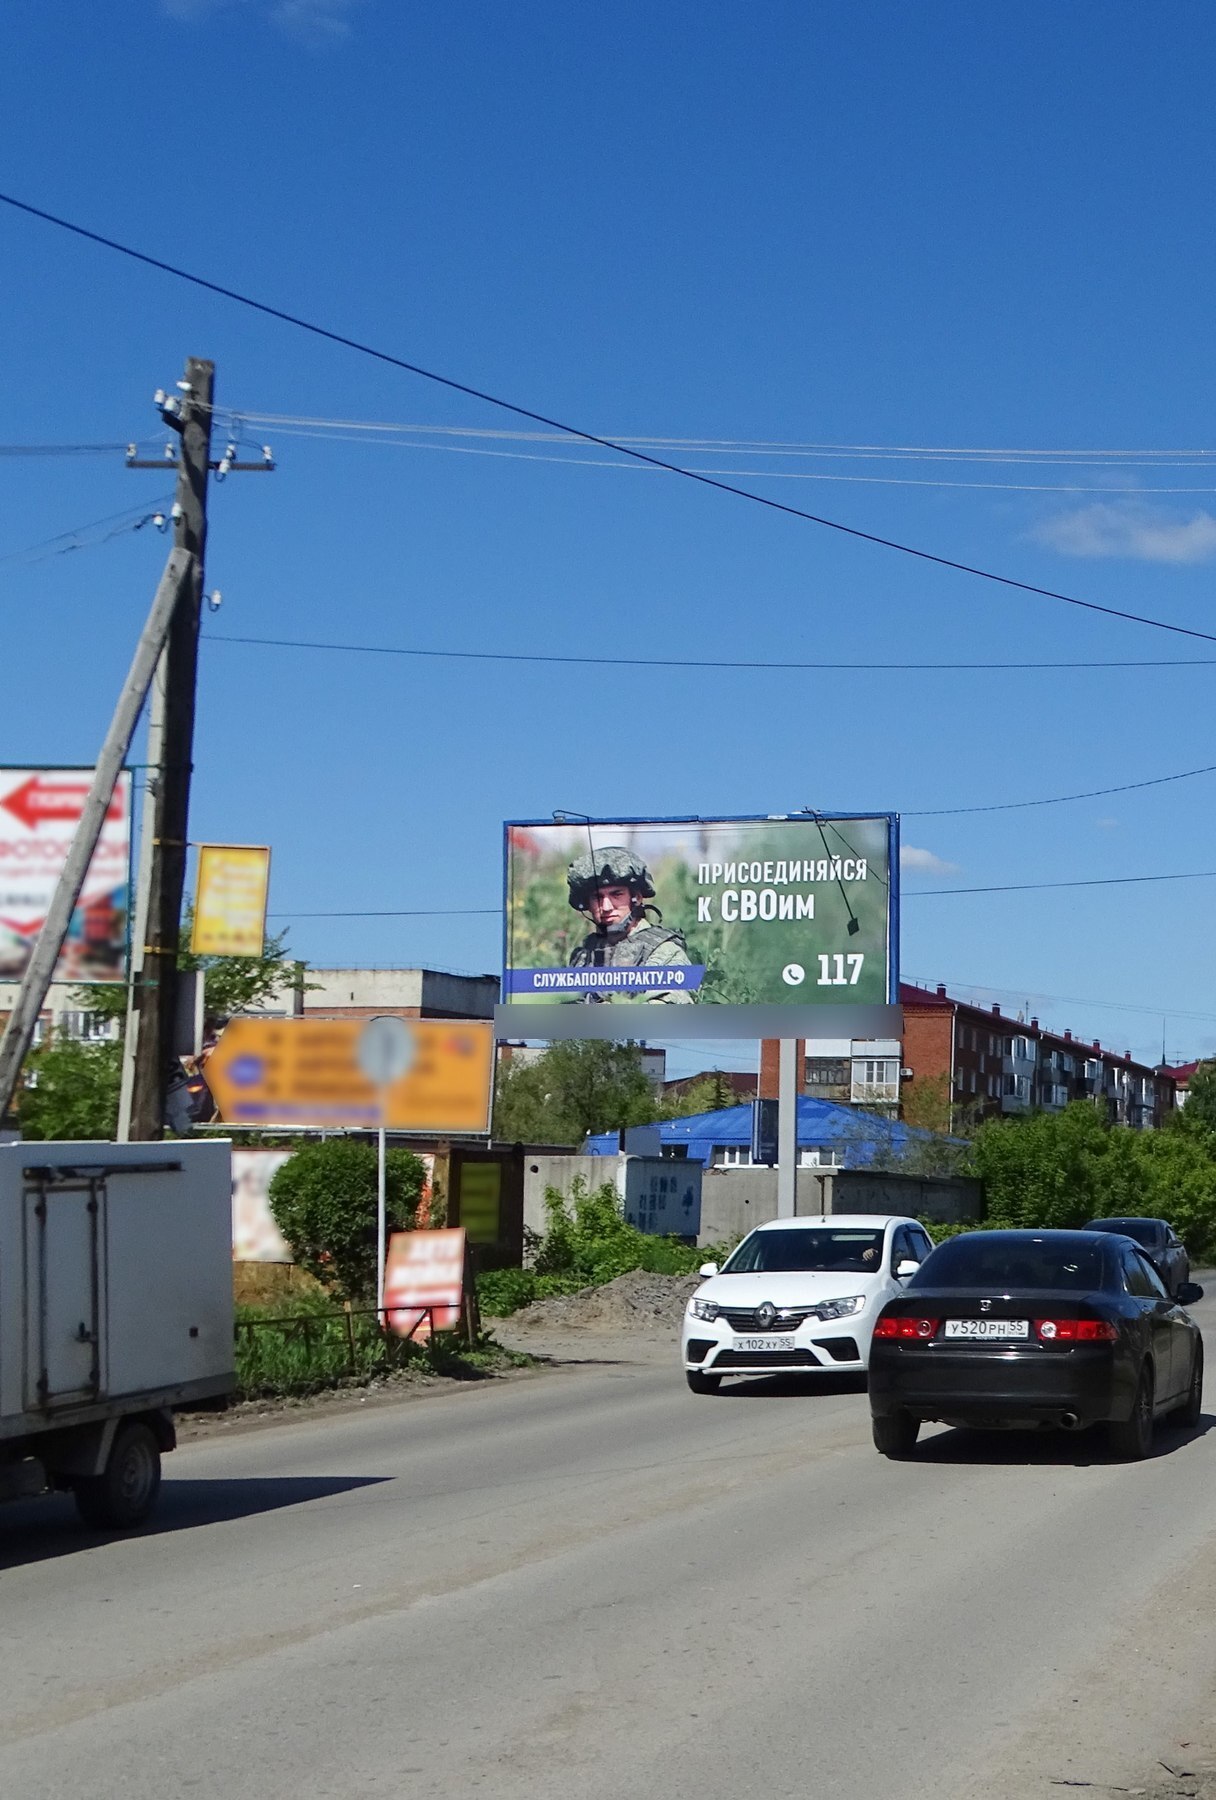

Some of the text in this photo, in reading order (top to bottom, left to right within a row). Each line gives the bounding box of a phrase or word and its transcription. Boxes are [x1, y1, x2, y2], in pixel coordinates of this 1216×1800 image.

[698, 855, 867, 885] ПРИСОЕДИНЯЙСЯ
[533, 970, 685, 988] СЛУЖБАПОКОНТРАКТУ.РФ
[817, 953, 864, 986] 117
